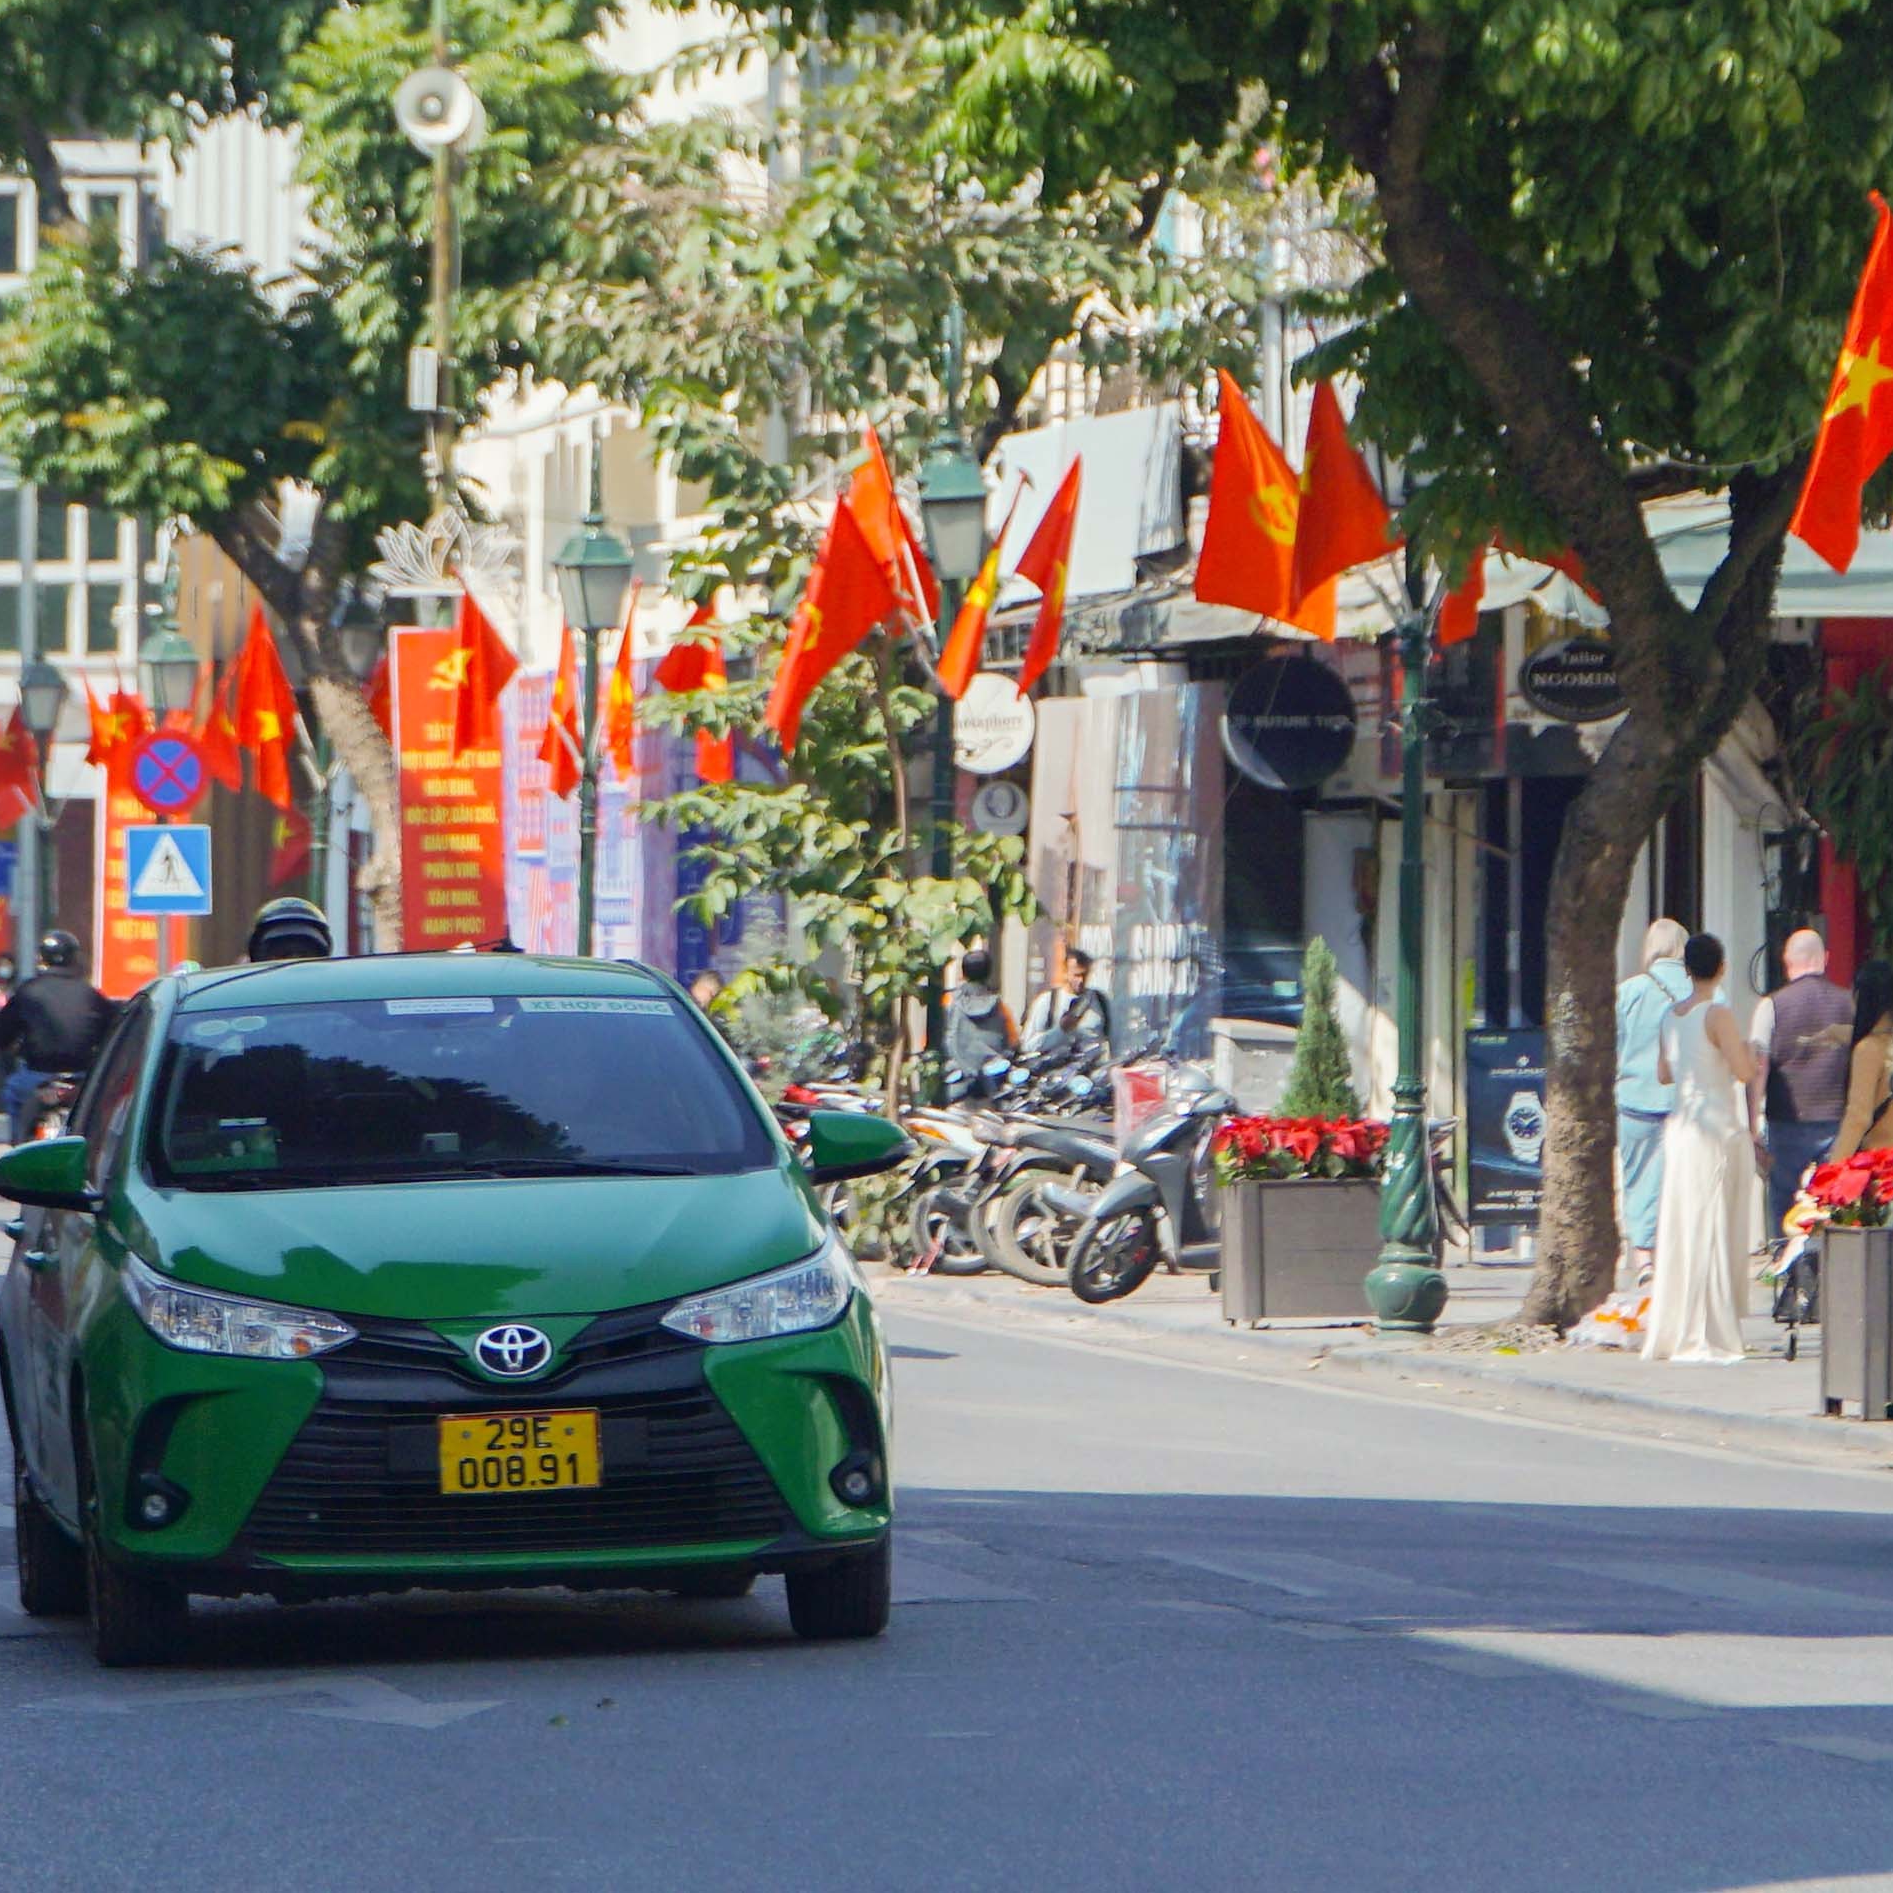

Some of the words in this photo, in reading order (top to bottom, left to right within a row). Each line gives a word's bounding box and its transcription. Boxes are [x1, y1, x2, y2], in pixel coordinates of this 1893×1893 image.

[1532, 672, 1617, 684] NGOMIN
[485, 1416, 553, 1450] 29E
[458, 1452, 579, 1489] 008.91
